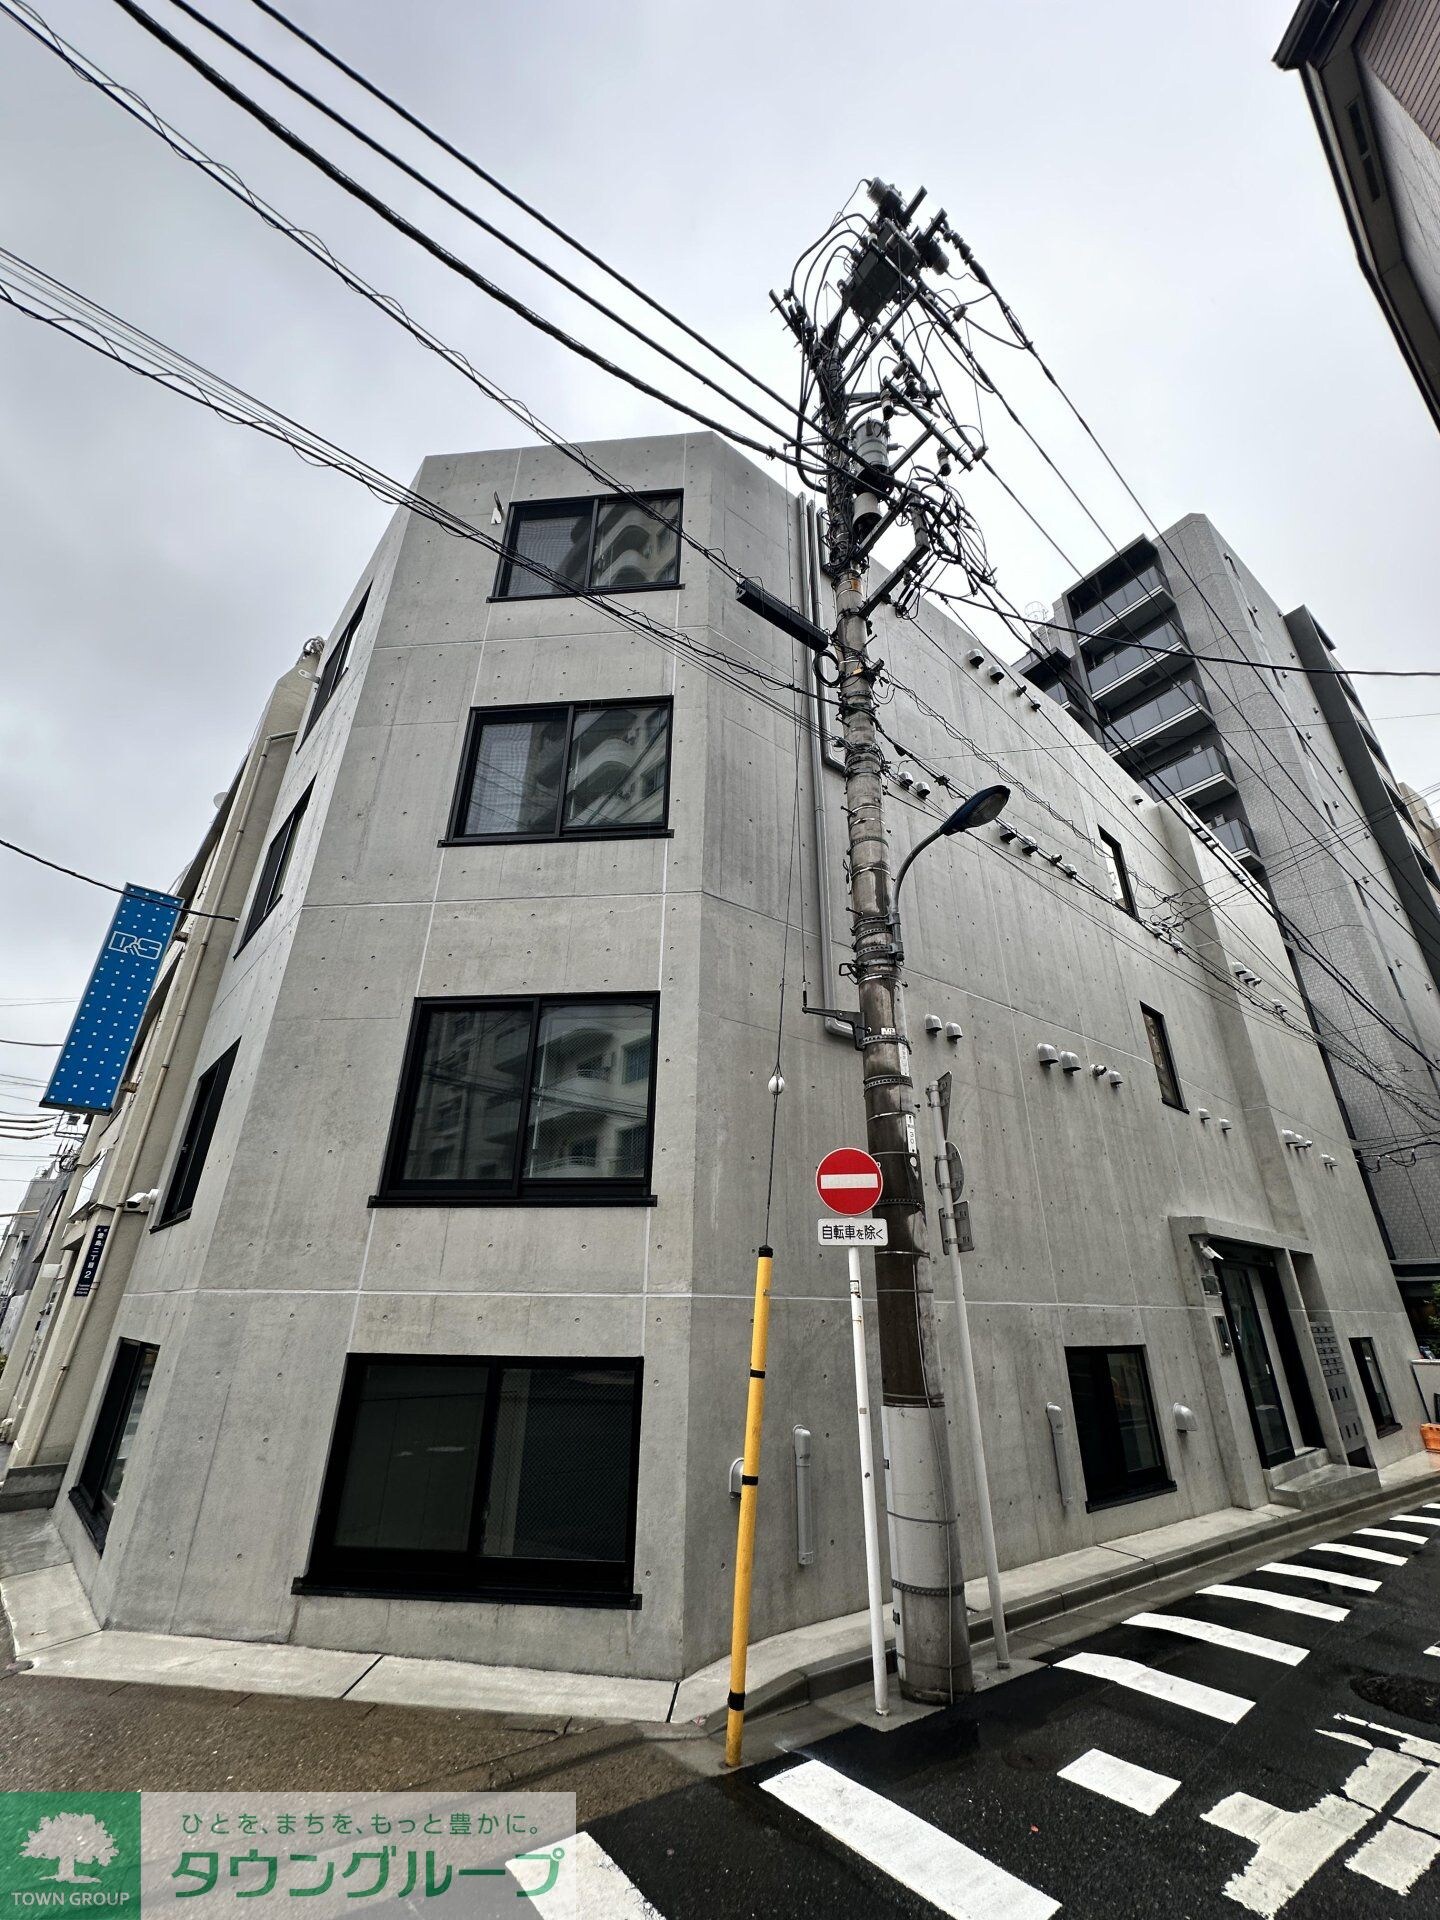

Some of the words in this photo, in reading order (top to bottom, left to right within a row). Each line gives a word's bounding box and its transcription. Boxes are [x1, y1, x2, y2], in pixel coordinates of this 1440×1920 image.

[822, 1224, 884, 1240] 自転車を除く
